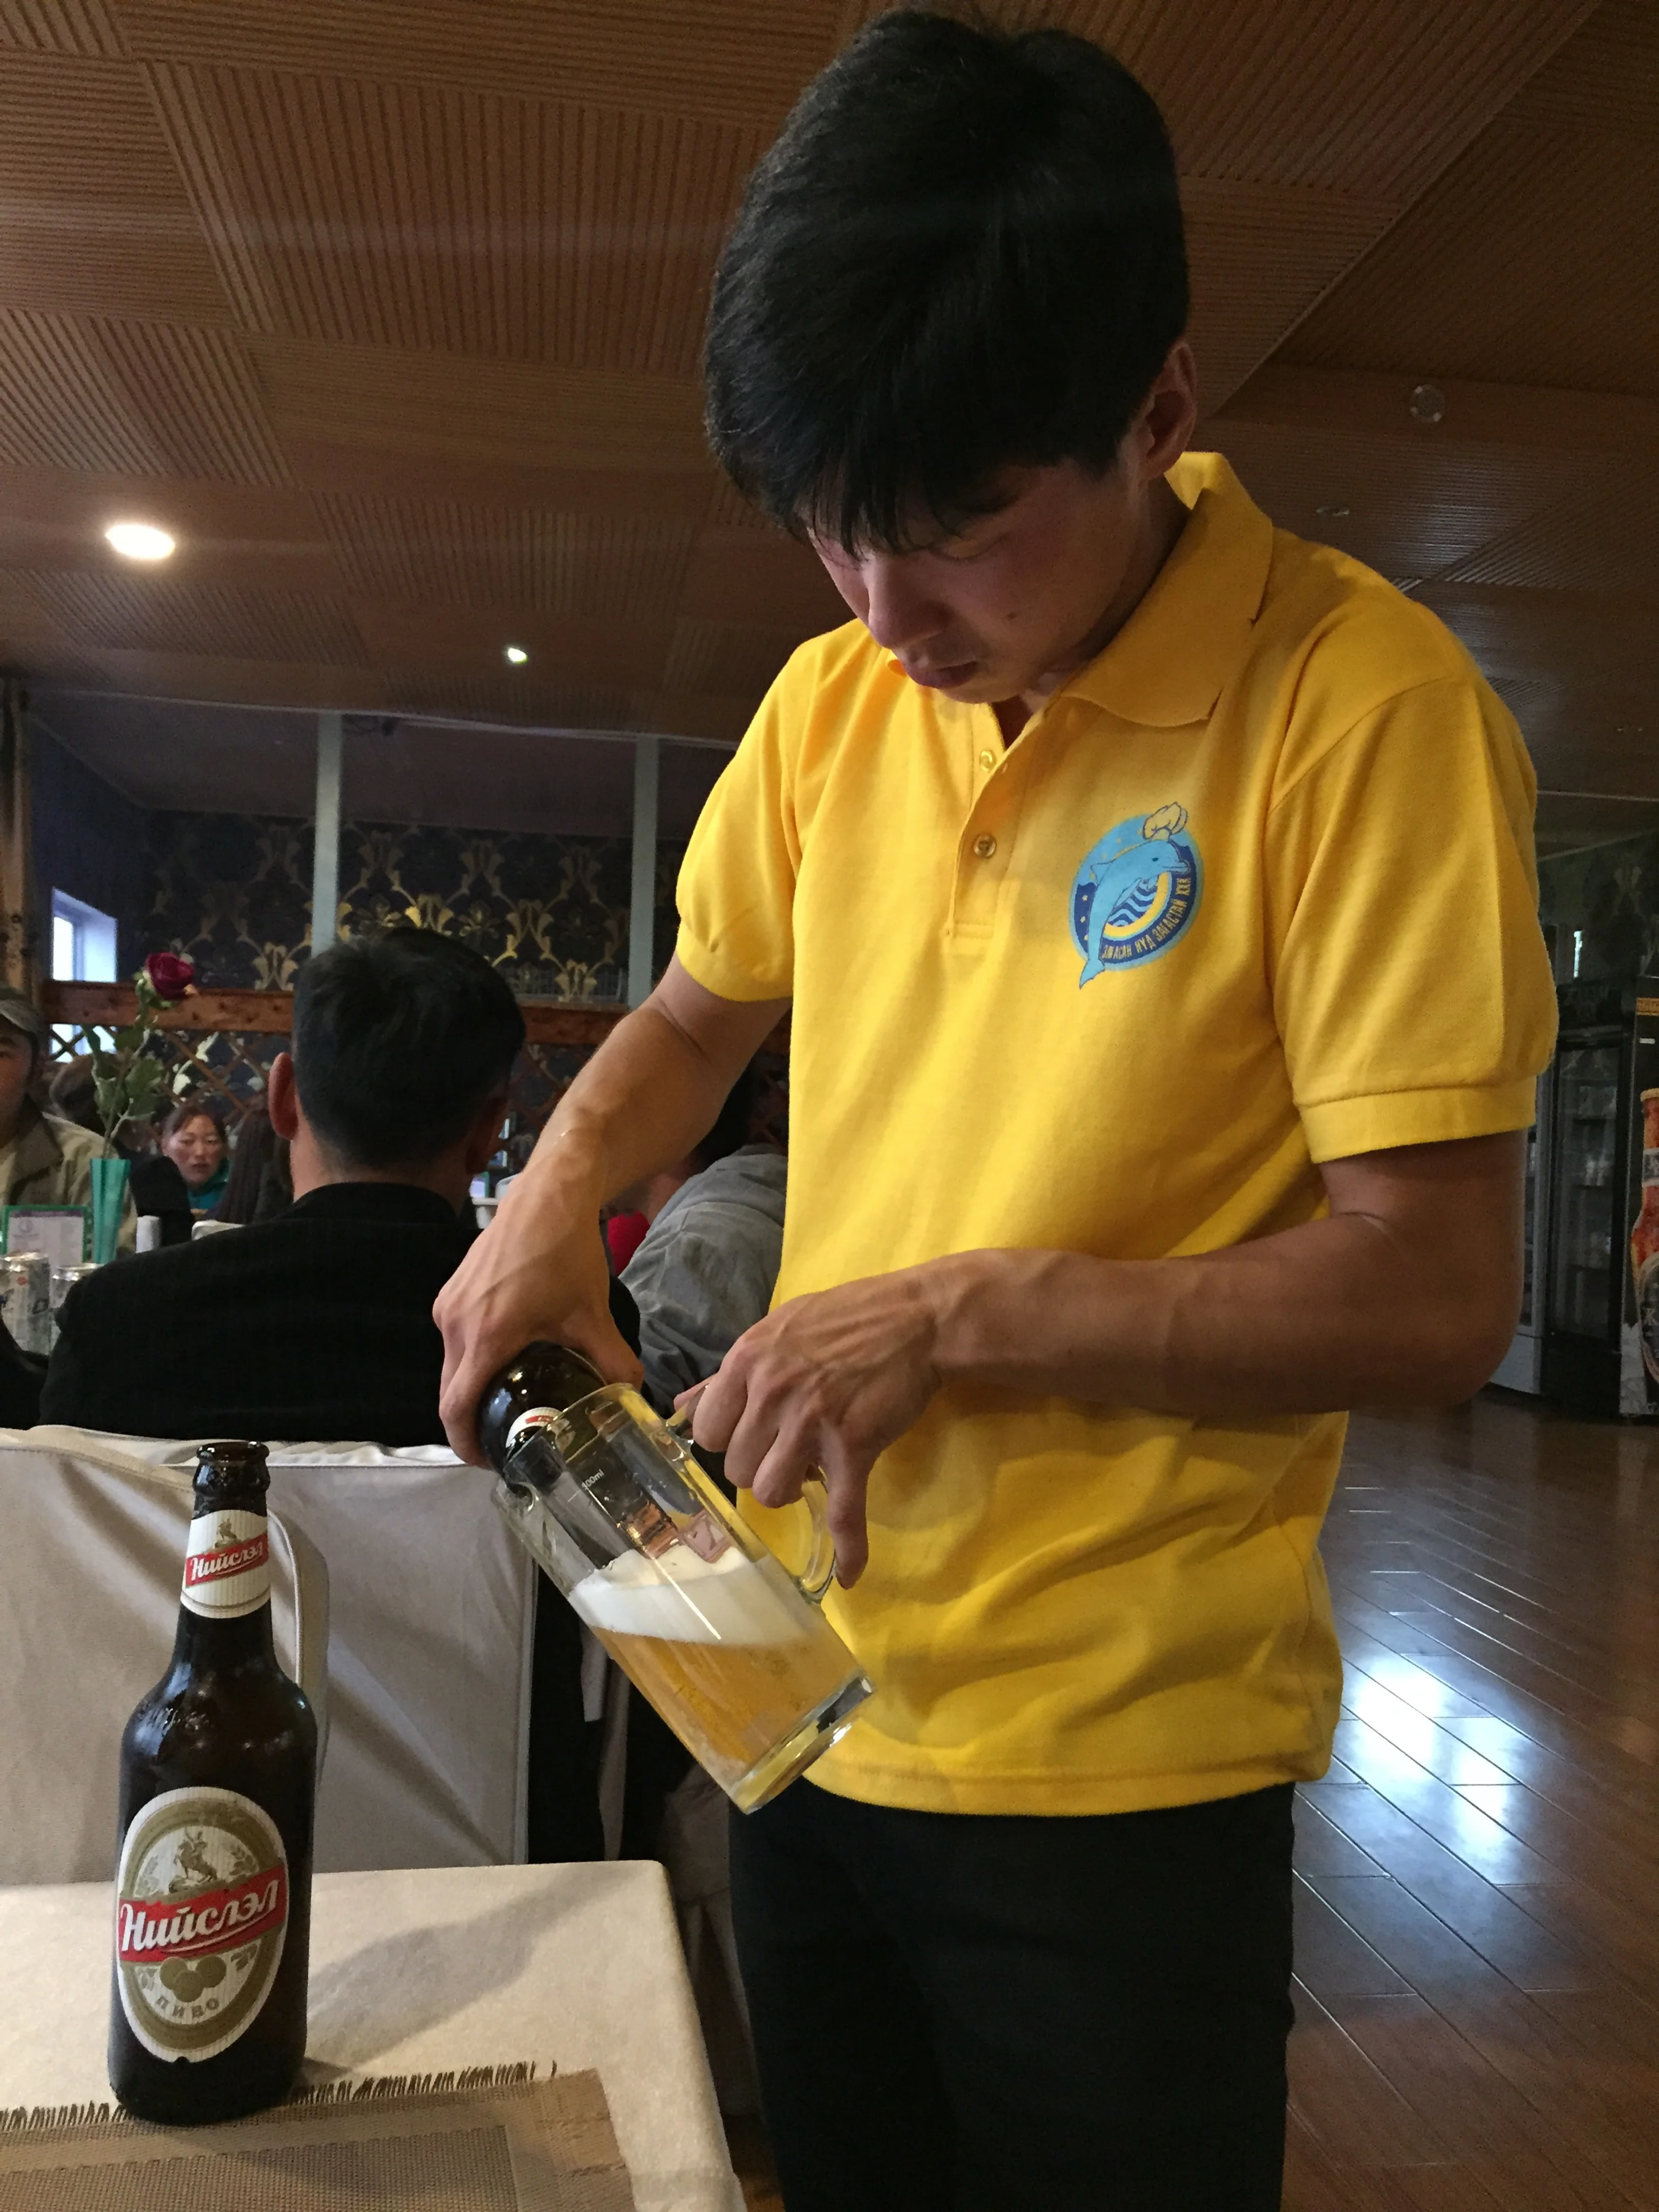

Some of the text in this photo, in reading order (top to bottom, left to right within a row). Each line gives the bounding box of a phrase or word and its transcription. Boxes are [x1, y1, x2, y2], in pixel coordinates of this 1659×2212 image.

[191, 1541, 263, 1581] Нийслэл
[120, 1879, 279, 1952] Нийслэл
[155, 1995, 220, 2018] ПИВО
